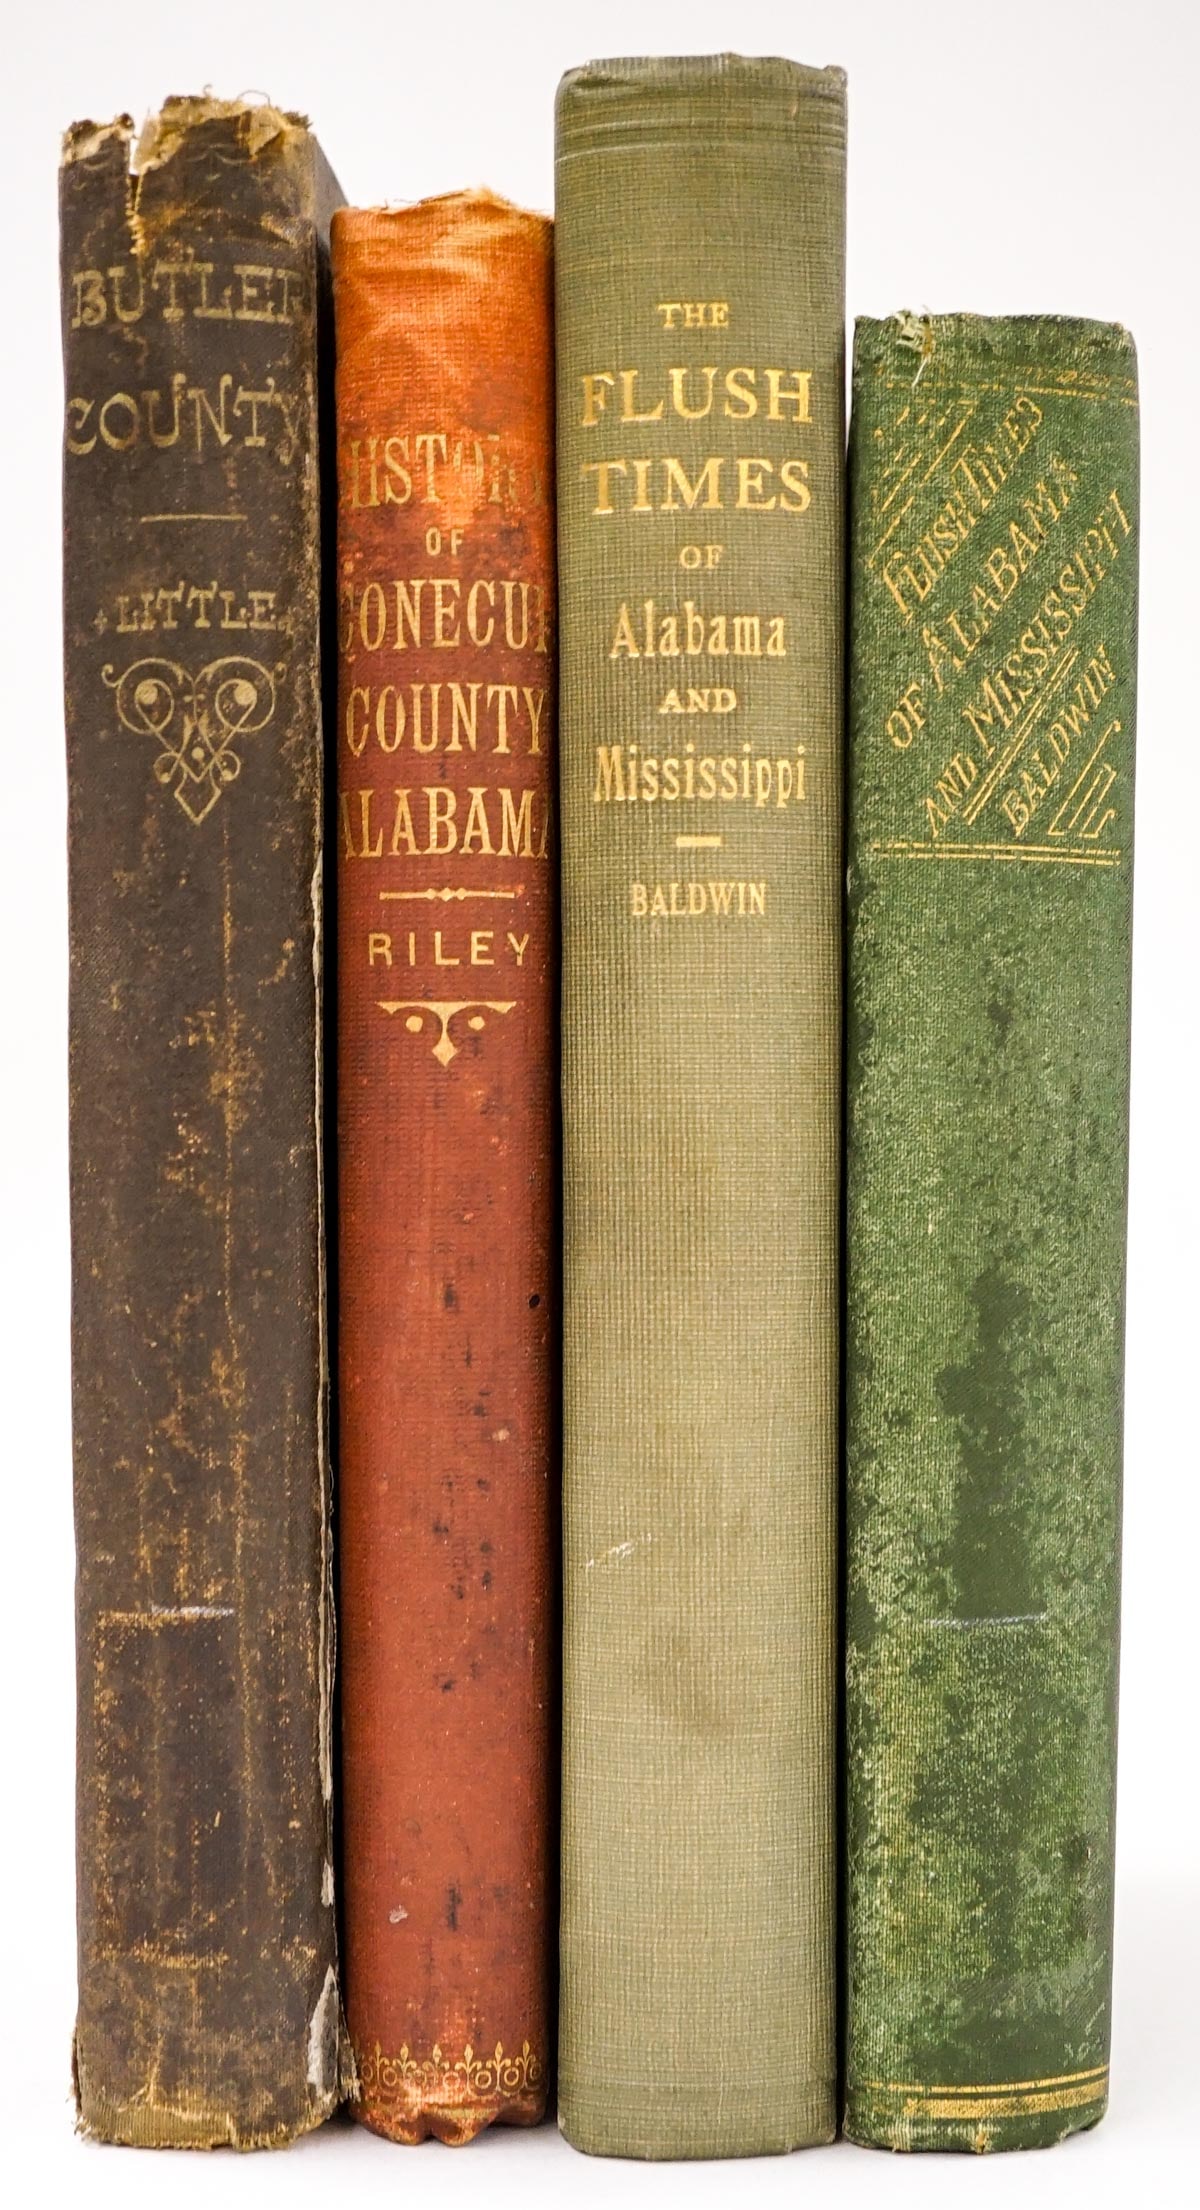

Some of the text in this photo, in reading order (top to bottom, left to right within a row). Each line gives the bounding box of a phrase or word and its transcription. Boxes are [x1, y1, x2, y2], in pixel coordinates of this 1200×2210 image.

[657, 301, 729, 329] THE
[66, 371, 305, 466] COUNTY
[581, 367, 813, 427] FLUSH
[581, 457, 812, 515] TIMES
[425, 526, 465, 556] OF
[679, 544, 724, 570] OF
[882, 489, 978, 626] FLUSH
[116, 580, 277, 633] LITTLE
[608, 599, 787, 659] Alabama
[885, 455, 1079, 749] OF ALABAMA
[346, 682, 546, 757] COUNTY
[659, 688, 738, 714] AND
[1001, 643, 1117, 838] BALDWIN
[594, 743, 806, 809] Mississippi
[924, 753, 979, 838] AND
[631, 882, 767, 917] BALDWIN
[368, 931, 530, 967] RILEY
